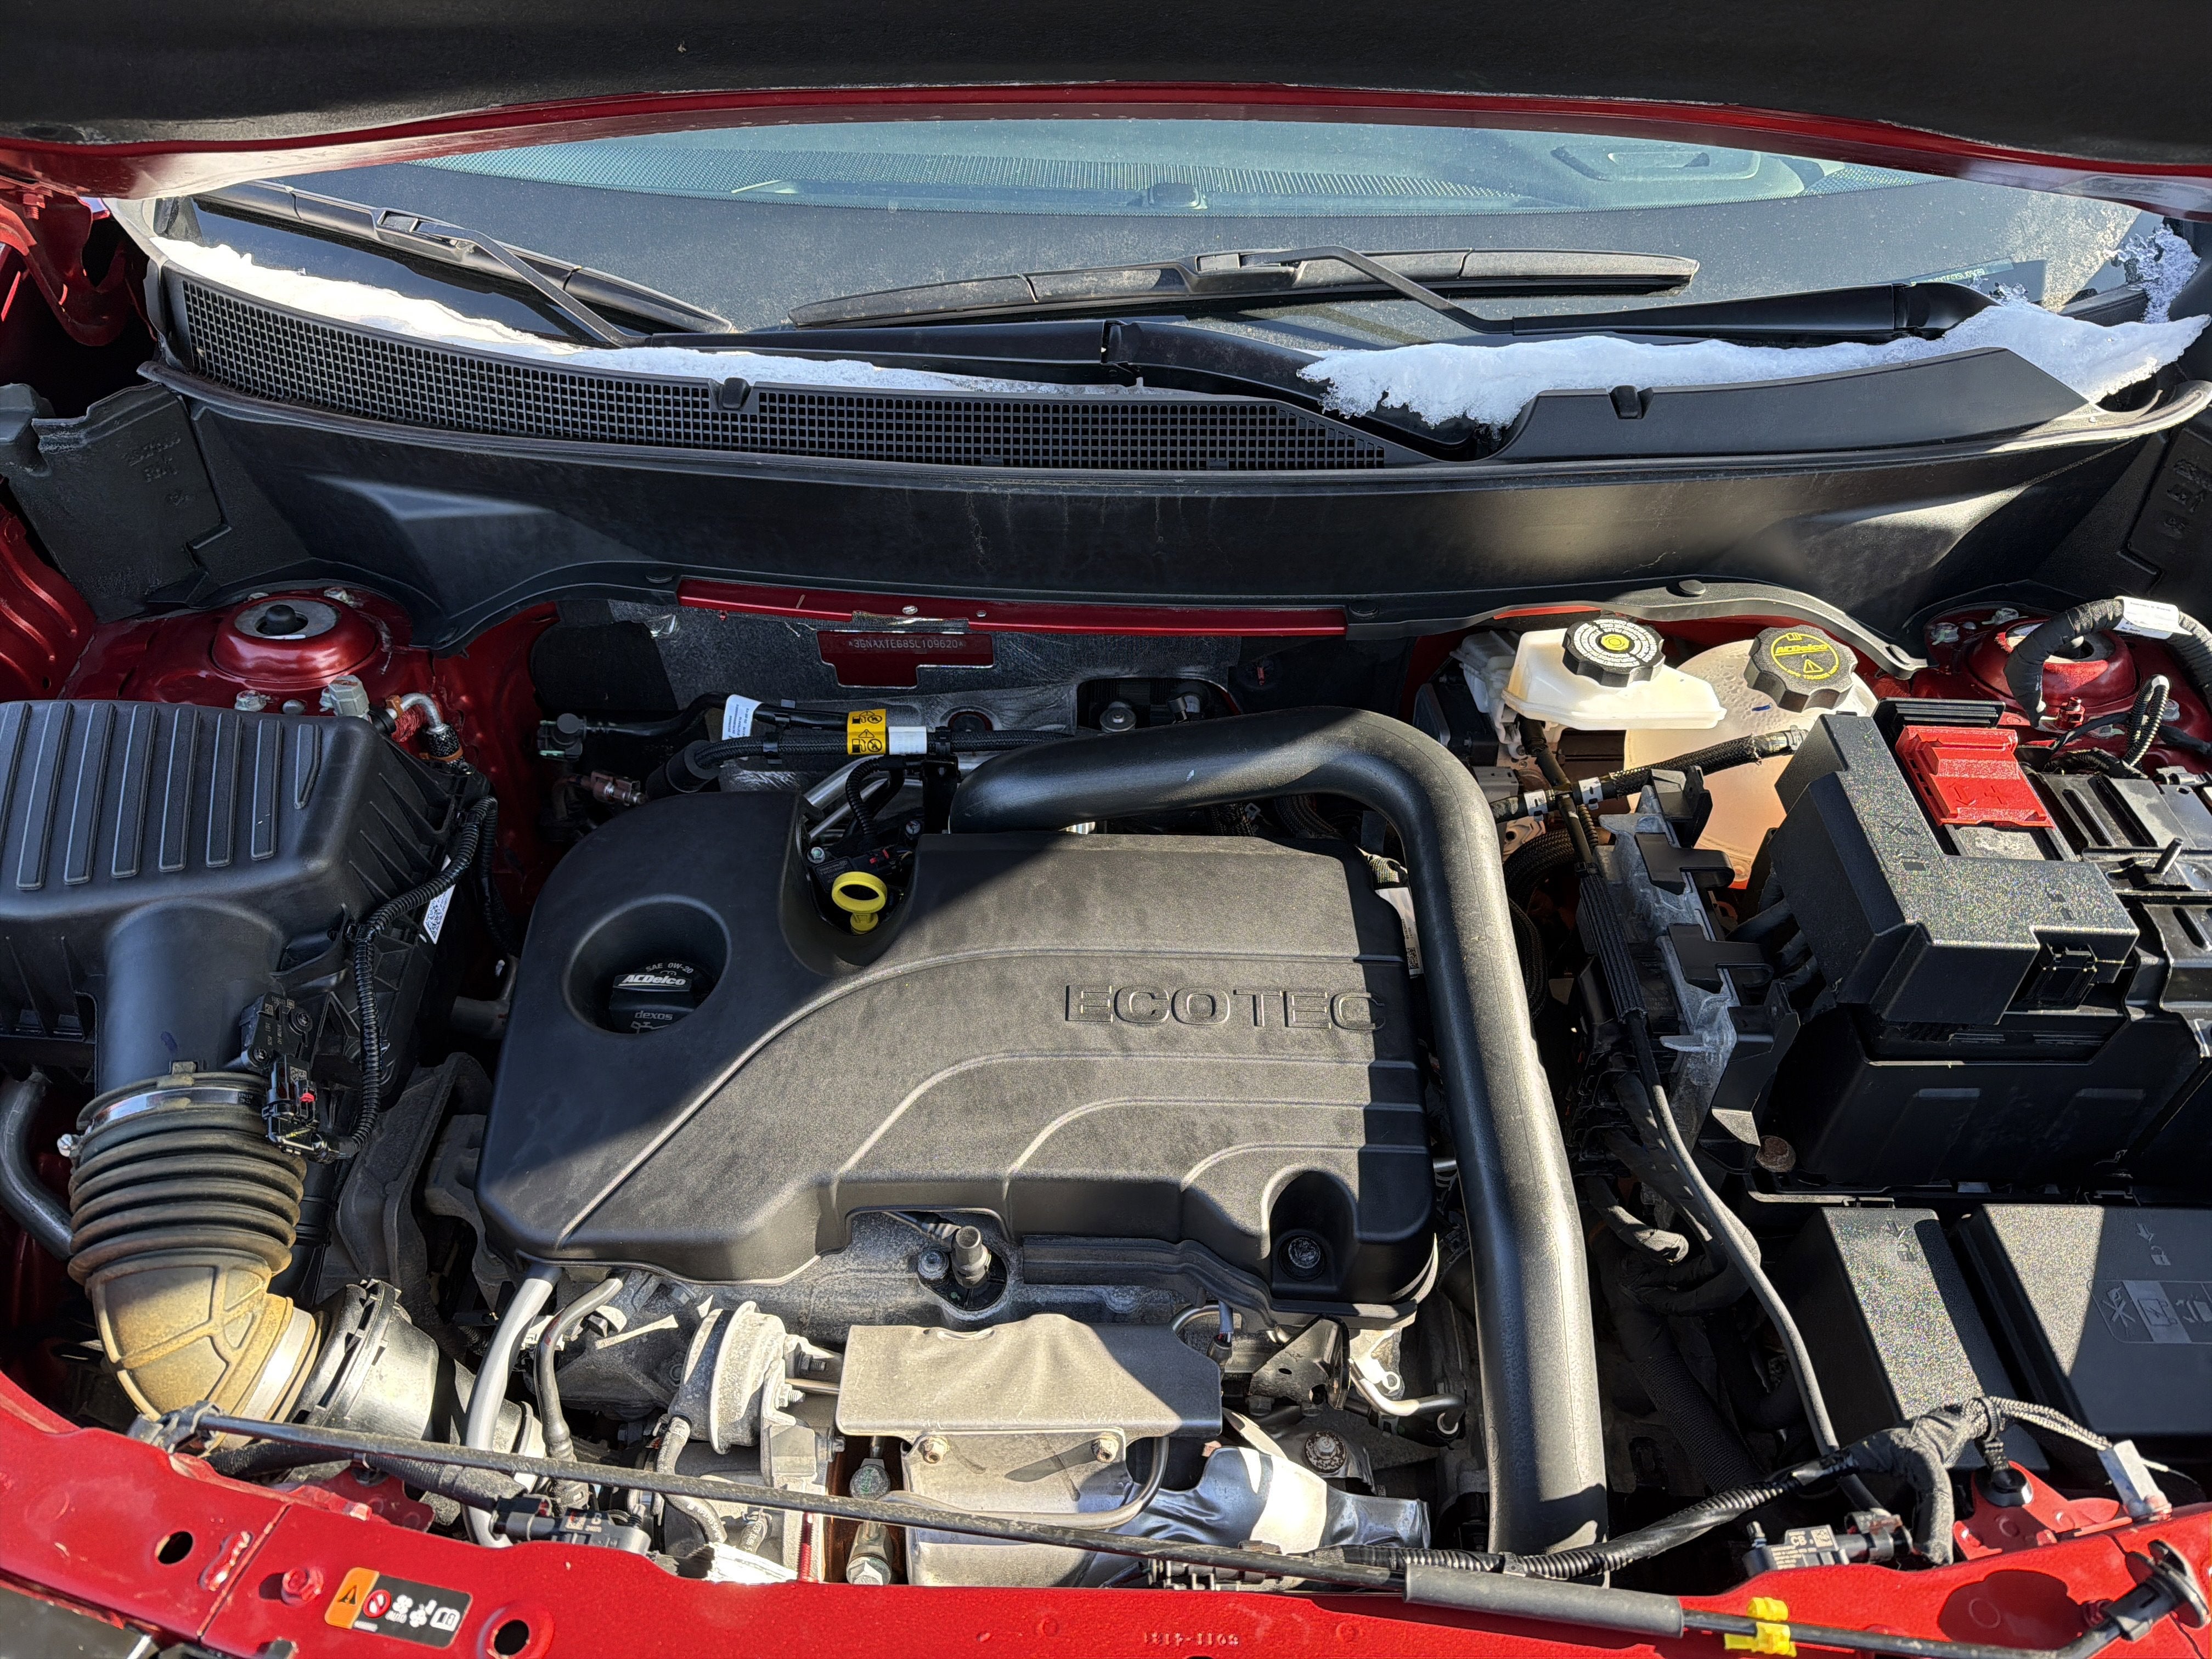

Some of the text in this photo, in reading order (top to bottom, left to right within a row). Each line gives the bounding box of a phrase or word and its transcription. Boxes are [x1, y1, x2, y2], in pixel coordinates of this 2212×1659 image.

[645, 962, 694, 974] SAE 0W-20
[621, 974, 686, 986] ACDelco
[1065, 985, 1385, 1031] ECOTEC
[634, 1010, 673, 1020] dexos
[591, 1512, 602, 1525] B
[1790, 1535, 1807, 1546] CB
